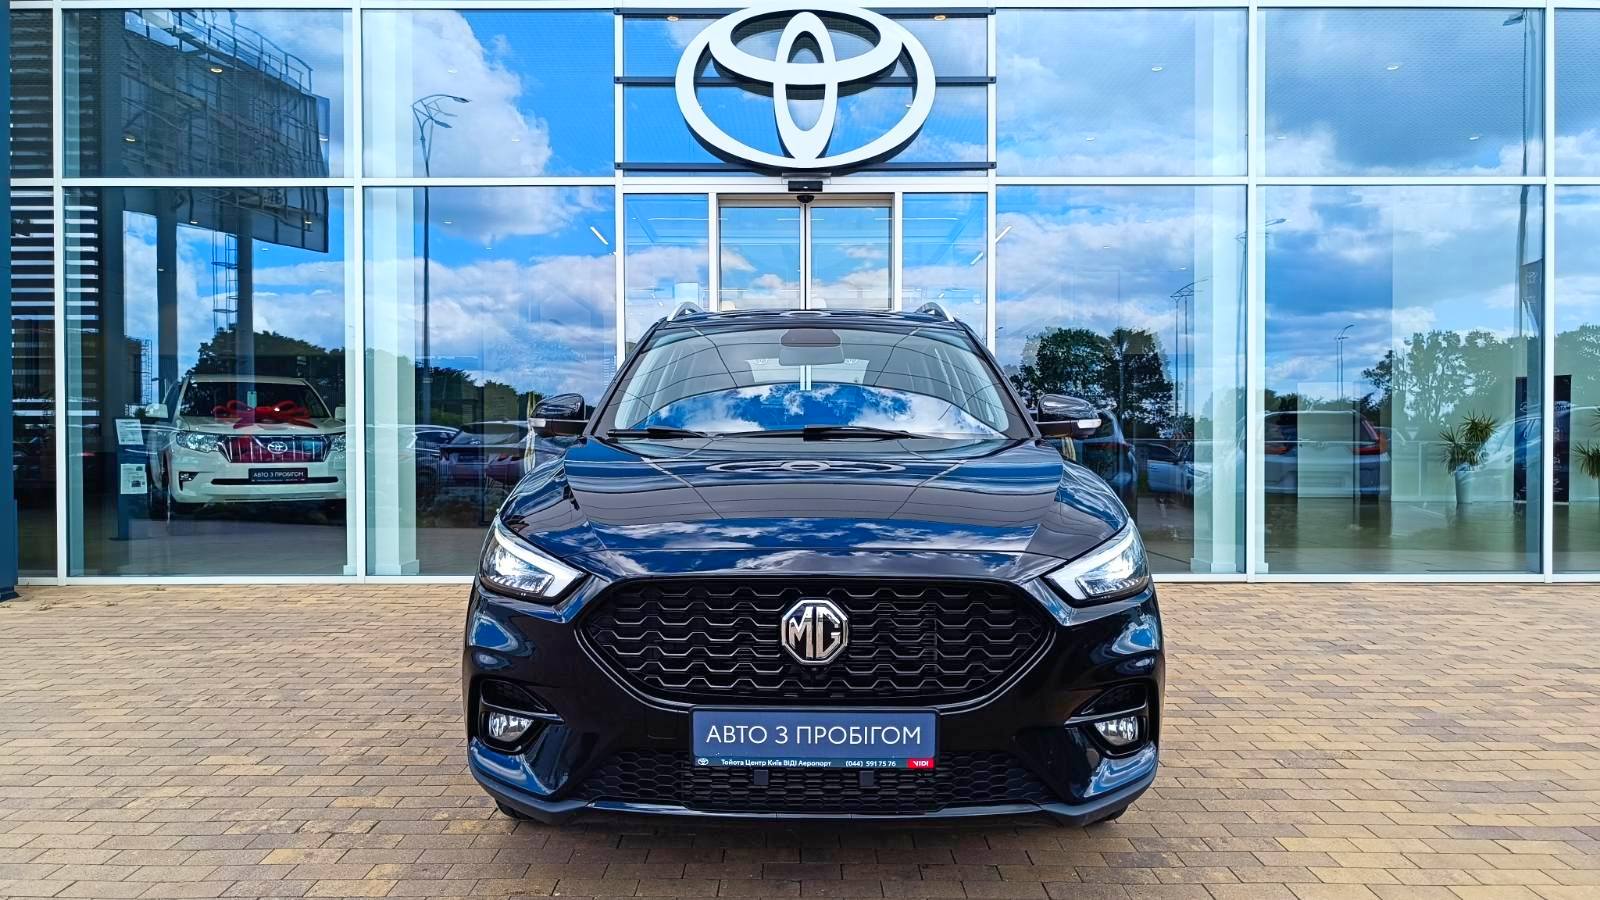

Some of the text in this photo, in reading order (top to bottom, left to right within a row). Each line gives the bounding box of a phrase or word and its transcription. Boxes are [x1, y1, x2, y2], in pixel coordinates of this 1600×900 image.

[788, 606, 841, 659] MG
[705, 725, 922, 745] АВТО З ПРОБІГОМ
[720, 758, 744, 766] Тойота
[745, 759, 767, 767] Центр
[767, 759, 782, 767] Київ
[798, 760, 832, 768] Аеропорт
[845, 760, 864, 768] (044)
